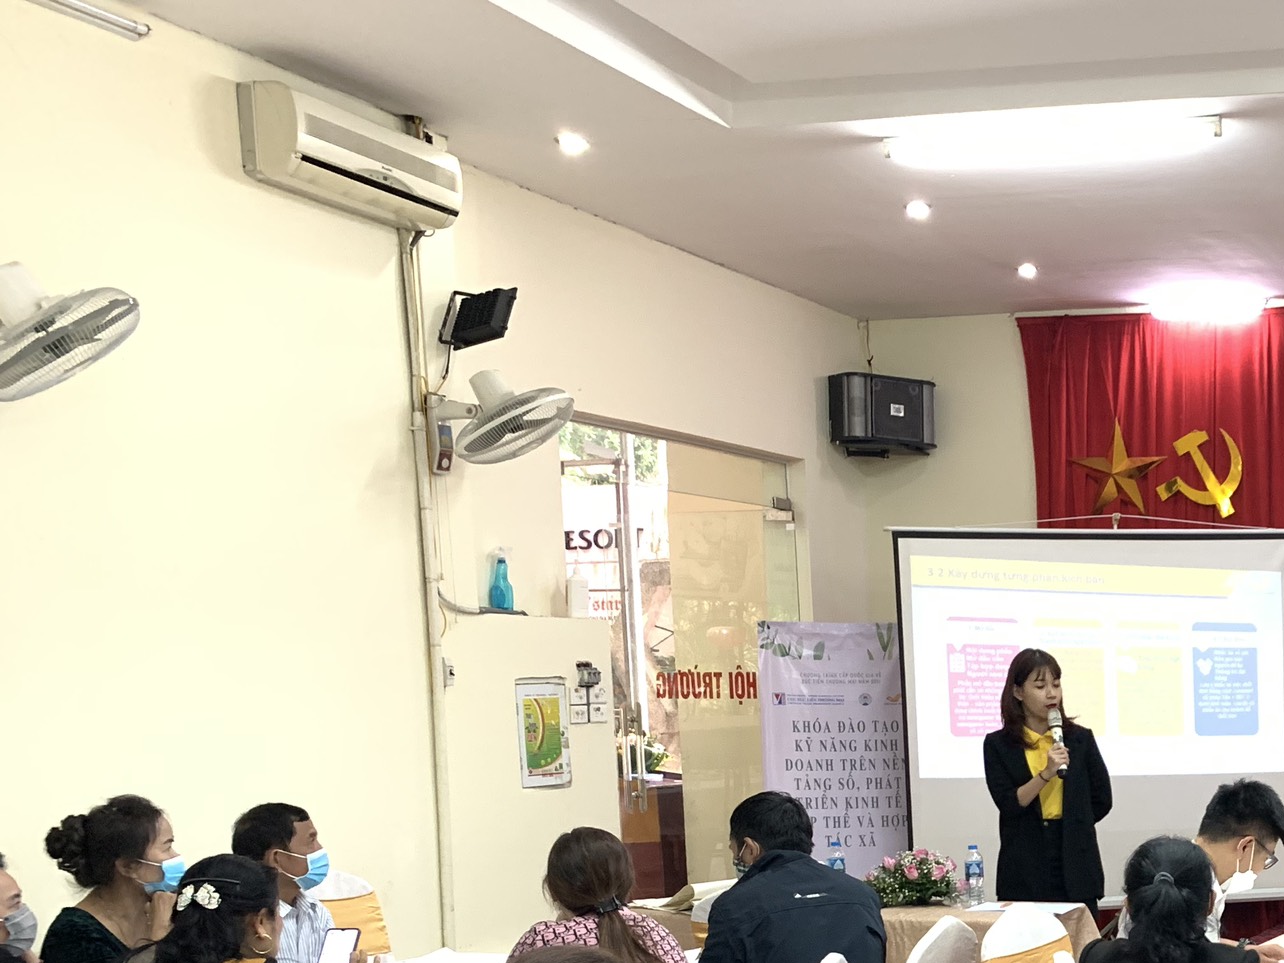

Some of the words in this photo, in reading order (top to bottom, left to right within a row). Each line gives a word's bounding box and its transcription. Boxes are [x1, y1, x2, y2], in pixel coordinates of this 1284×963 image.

[792, 718, 831, 733] KHÓA
[838, 717, 866, 733] ĐÀO
[872, 720, 899, 736] TẠO
[795, 736, 812, 752] KỸ
[820, 736, 857, 752] NĂNG
[864, 739, 898, 752] KINH
[785, 758, 834, 771] DOANH
[840, 755, 876, 771] TRÊN
[794, 774, 832, 791] TẢNG
[838, 772, 860, 792] SỐ,
[866, 774, 901, 790] PHÁT
[845, 796, 879, 810] KINH
[886, 790, 902, 808] TẾ
[823, 809, 850, 828] THỂ
[857, 812, 874, 828] VÀ
[825, 832, 852, 848] TÁC
[859, 832, 876, 847] XÃ
